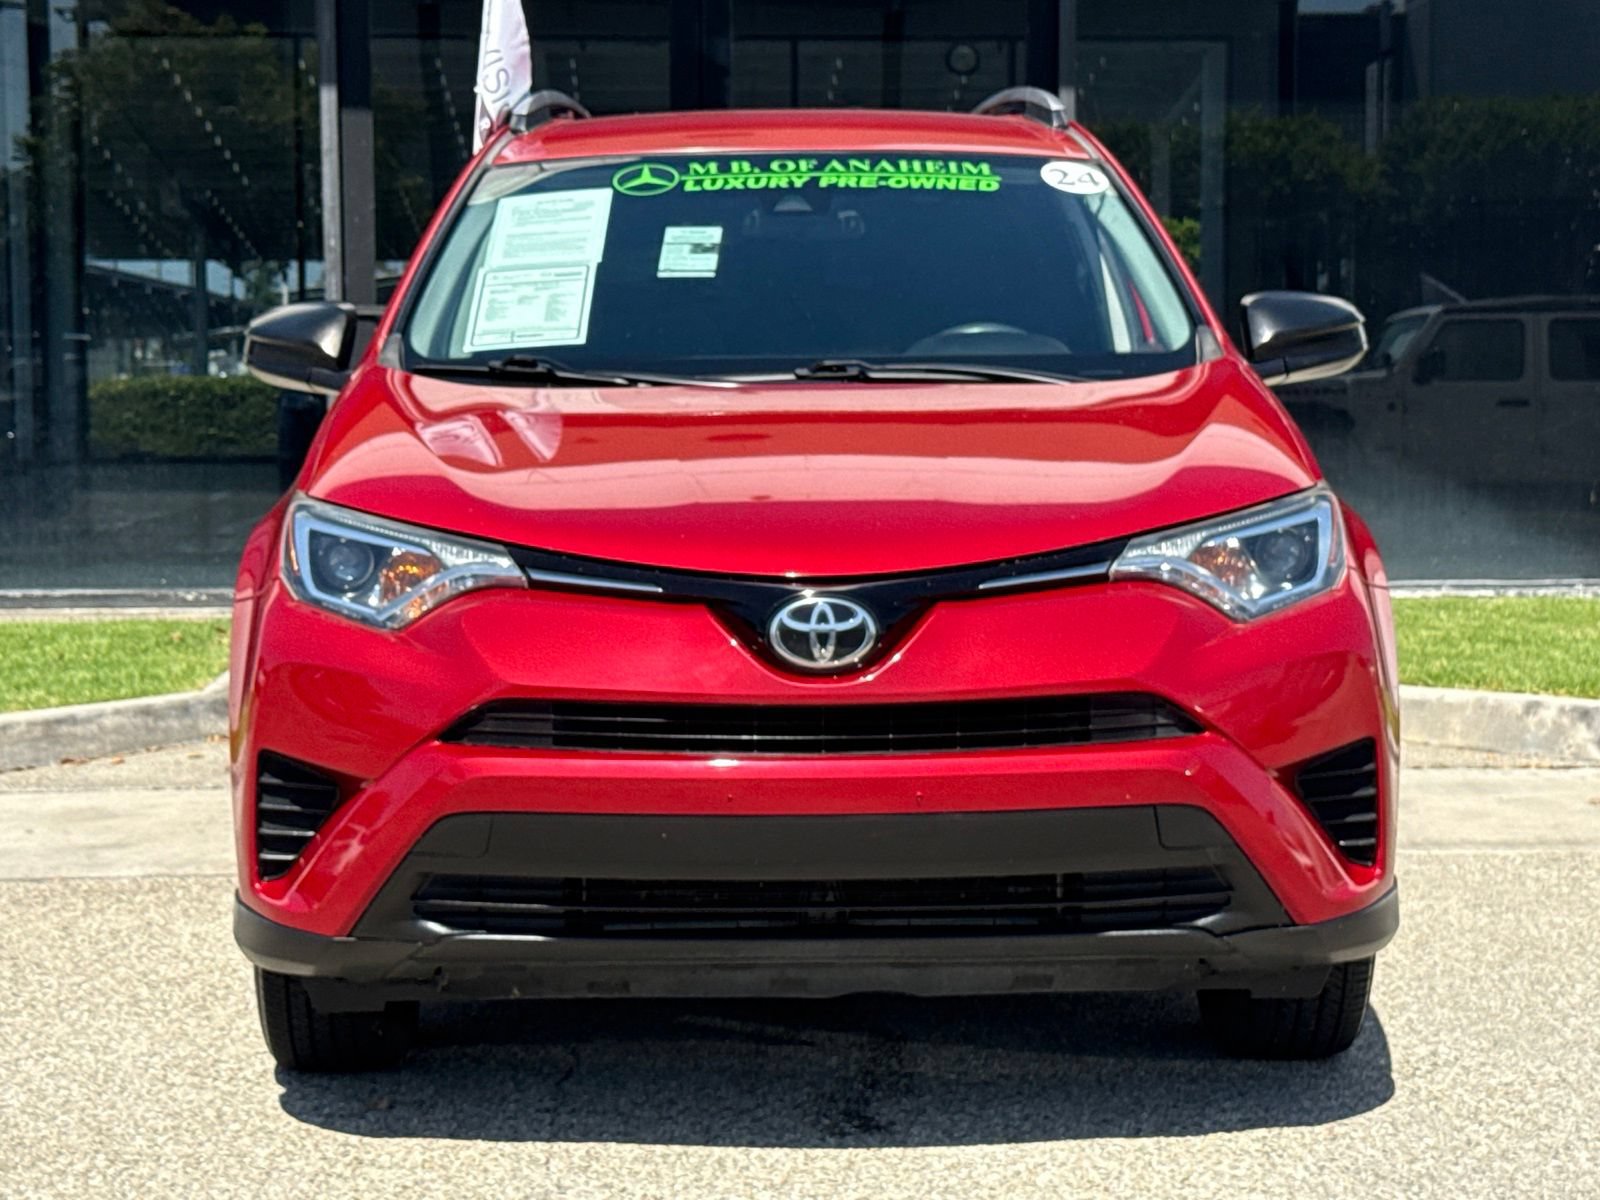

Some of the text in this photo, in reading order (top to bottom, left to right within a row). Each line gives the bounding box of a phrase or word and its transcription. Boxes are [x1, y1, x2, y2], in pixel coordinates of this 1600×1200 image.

[770, 159, 818, 173] OF
[824, 158, 992, 176] ANAHEIM
[683, 175, 1001, 192] LUXURY PRE-OWNED
[1049, 168, 1100, 187] 24
